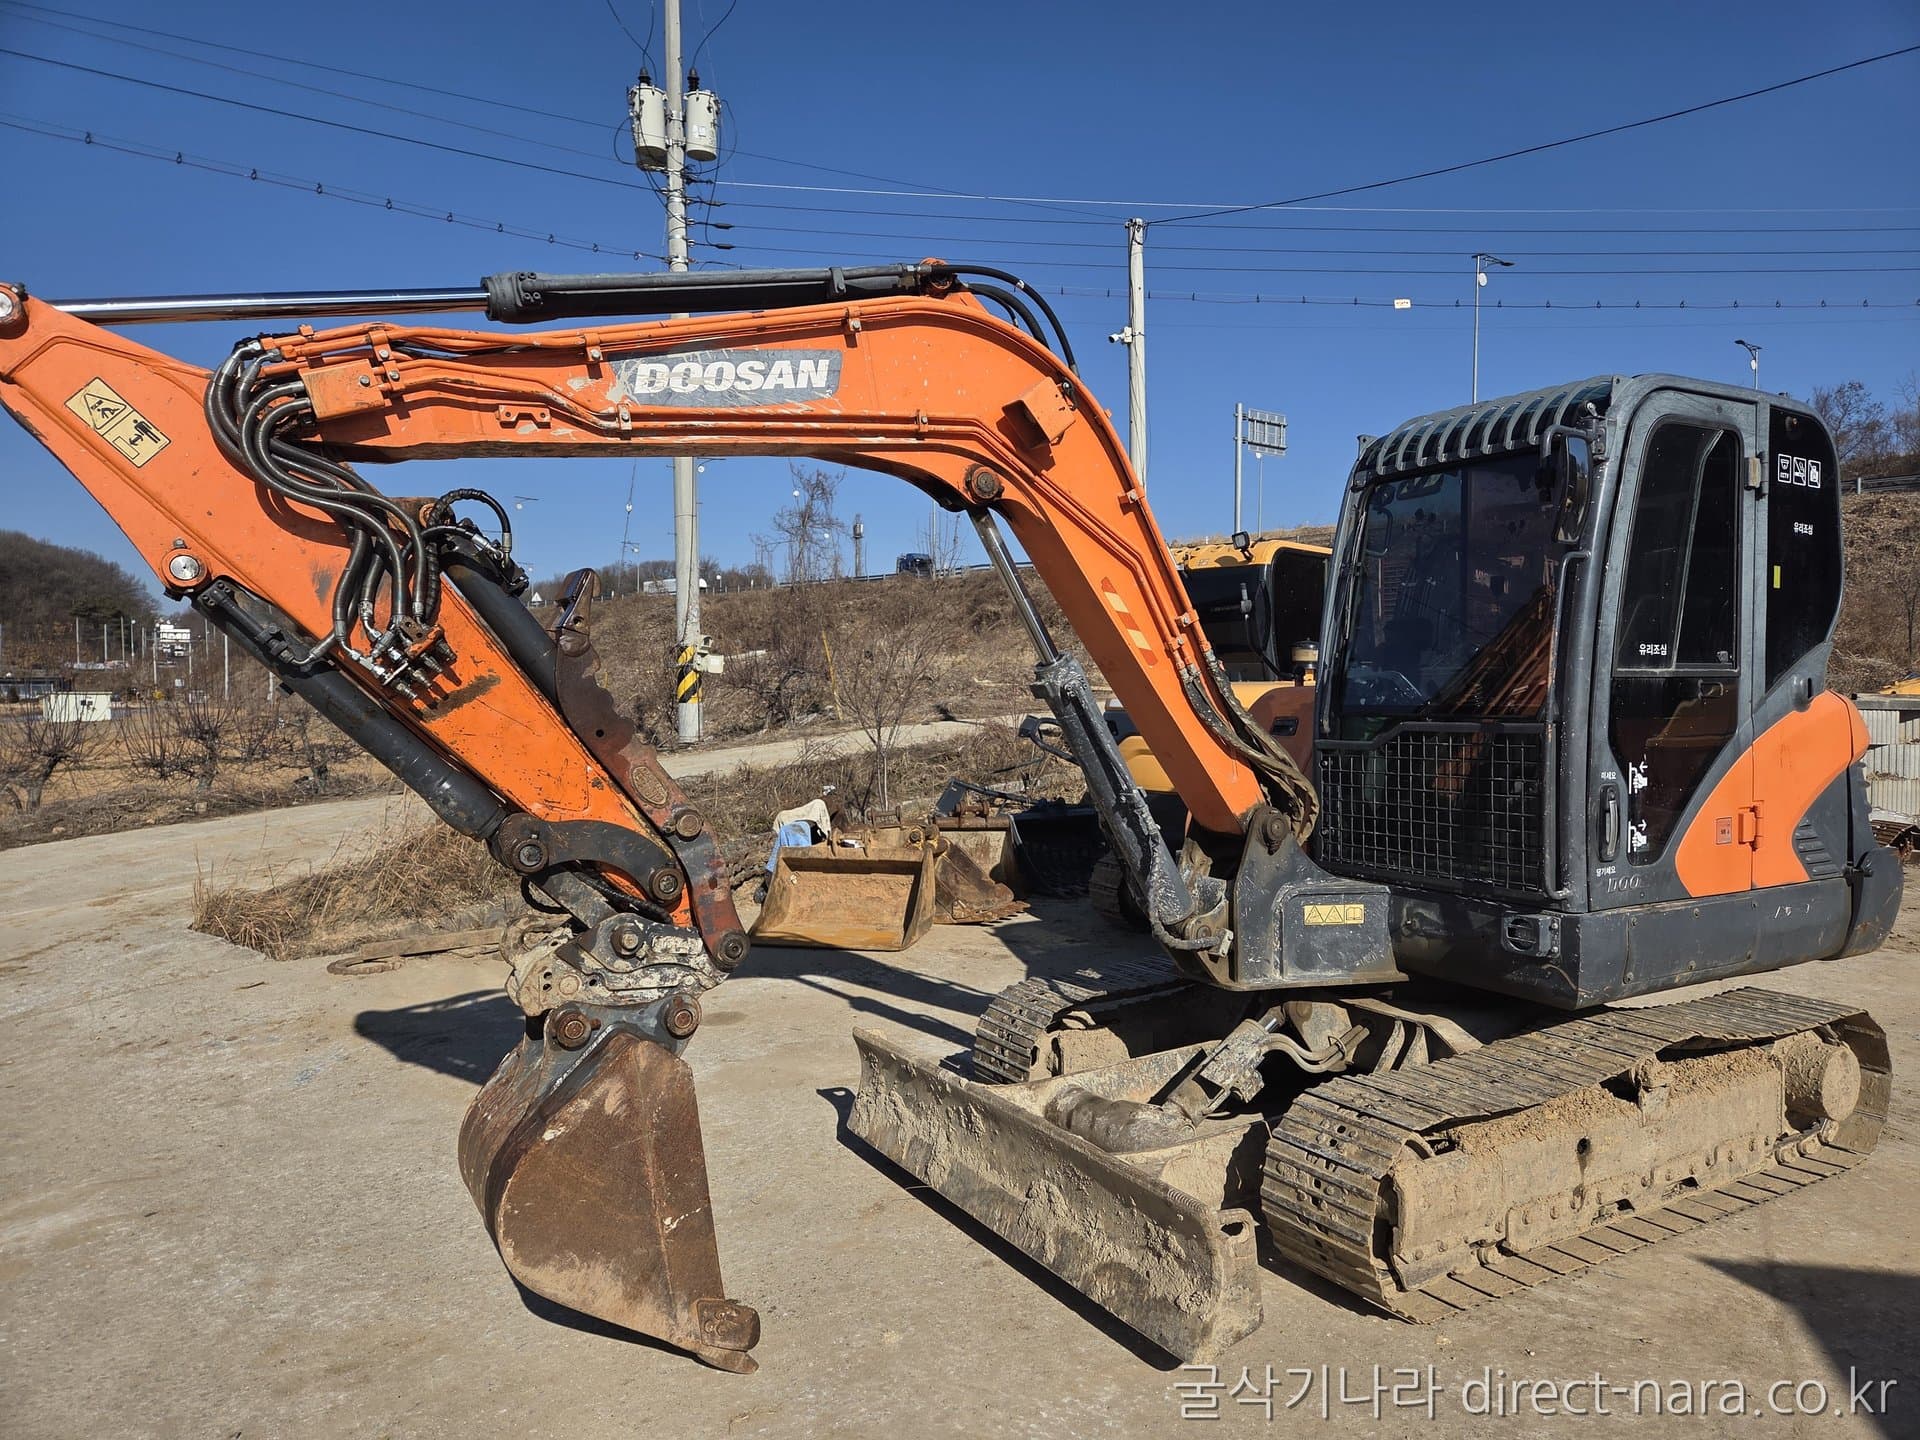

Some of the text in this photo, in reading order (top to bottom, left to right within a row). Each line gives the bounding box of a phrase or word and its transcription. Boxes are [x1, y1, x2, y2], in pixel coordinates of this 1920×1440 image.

[633, 359, 830, 394] DOOSAN
[1793, 521, 1813, 535] 유리조심
[1639, 643, 1667, 656] 유리조심
